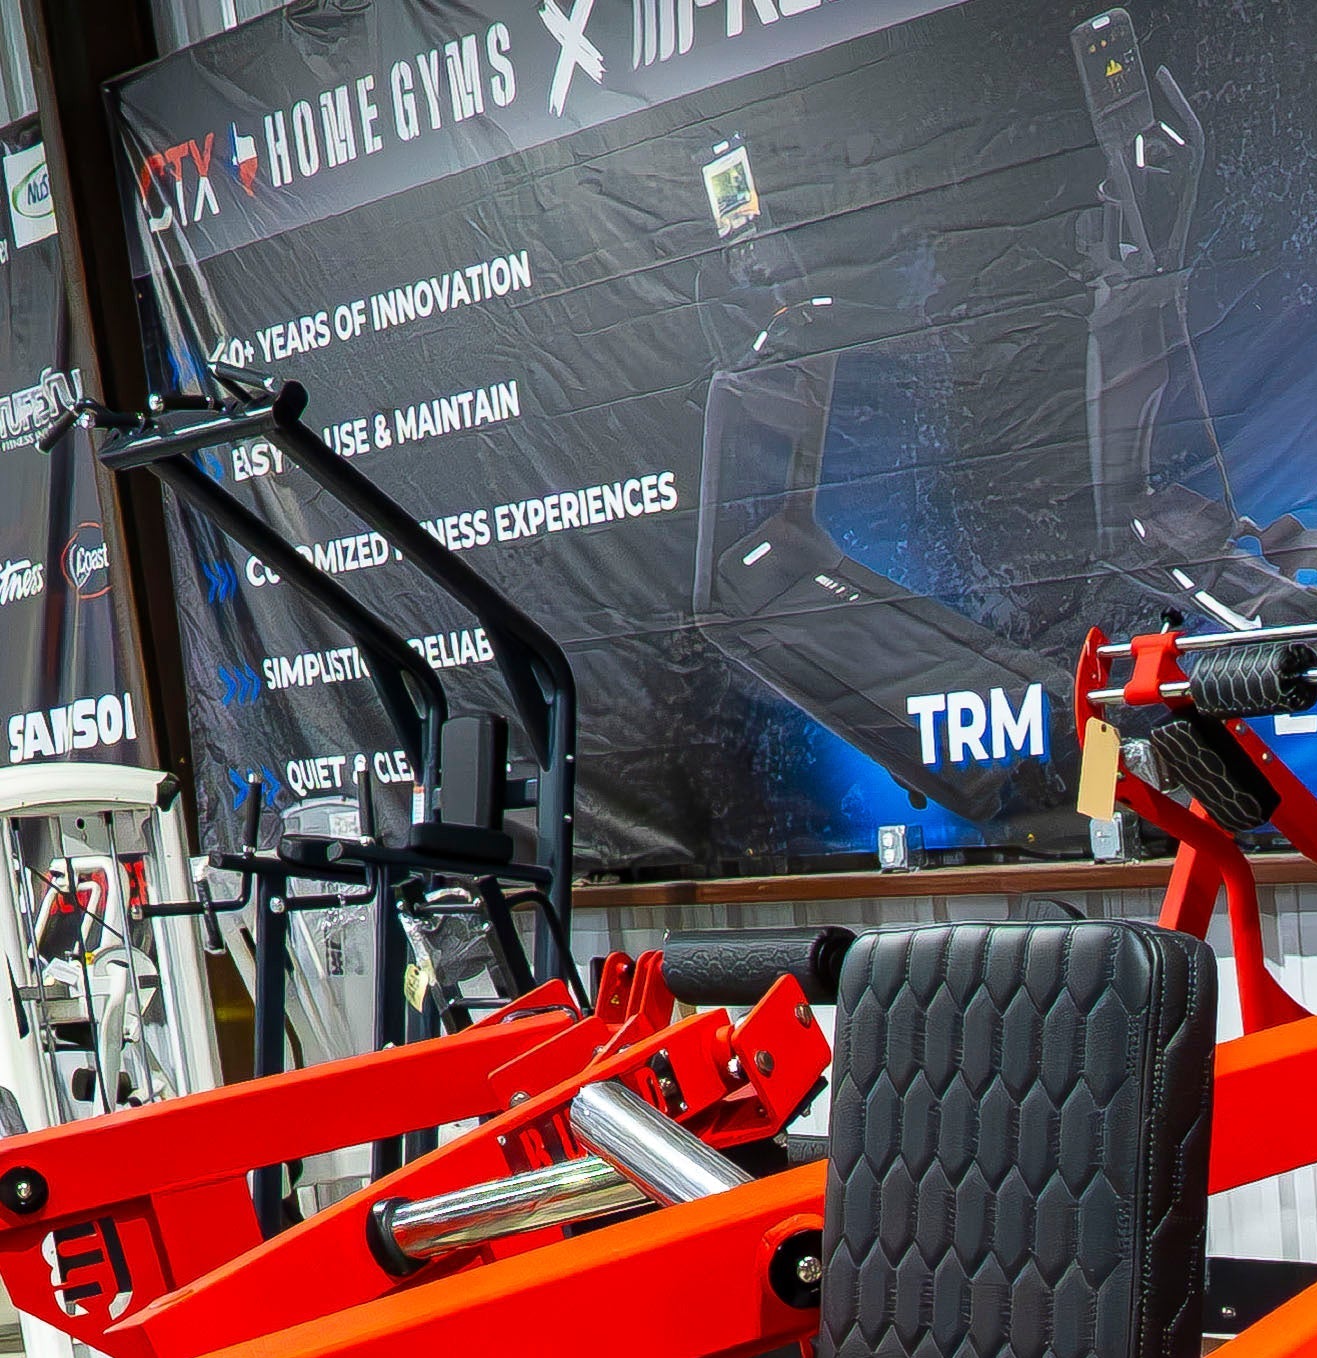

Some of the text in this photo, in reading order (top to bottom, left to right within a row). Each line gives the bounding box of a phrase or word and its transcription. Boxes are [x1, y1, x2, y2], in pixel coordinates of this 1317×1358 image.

[264, 75, 383, 187] HOME
[391, 22, 516, 141] GYMS
[256, 311, 332, 363] YEARS
[334, 300, 367, 341] OF
[371, 251, 533, 332] INNOVATION
[323, 418, 370, 458] USE
[374, 414, 392, 450] &
[395, 379, 521, 445] MAINTAIN
[494, 470, 679, 542] EXPERIENCES
[0, 559, 44, 606] tness
[906, 683, 1045, 767] TRM
[286, 755, 346, 797] QUIET
